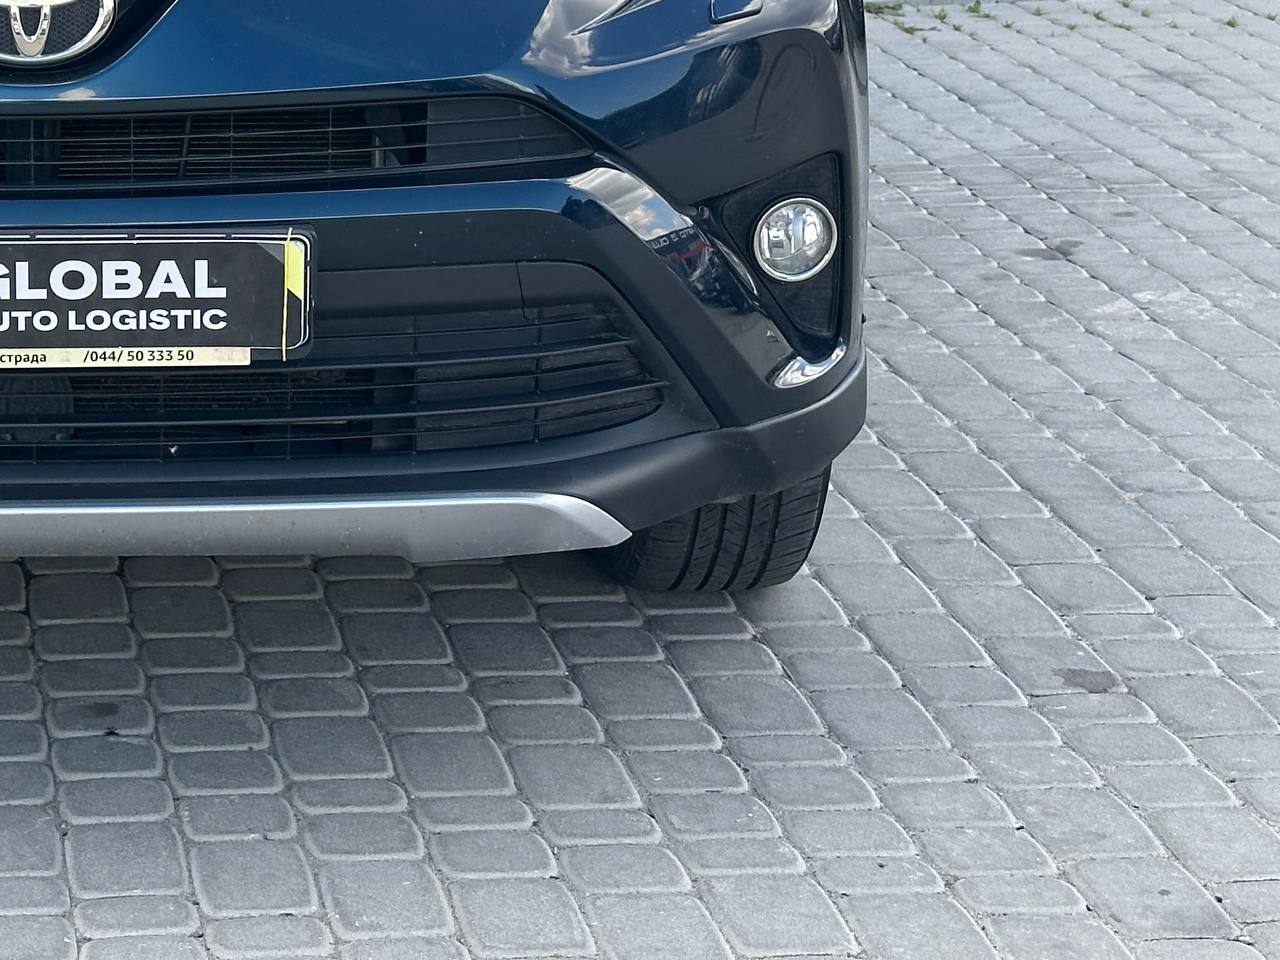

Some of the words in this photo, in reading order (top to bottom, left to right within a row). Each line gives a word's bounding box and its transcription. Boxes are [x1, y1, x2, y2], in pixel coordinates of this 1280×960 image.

[68, 308, 229, 332] LOGISTIC
[83, 349, 123, 365] /044/
[126, 350, 145, 363] 50
[146, 350, 174, 363] 333
[176, 350, 195, 362] 50
